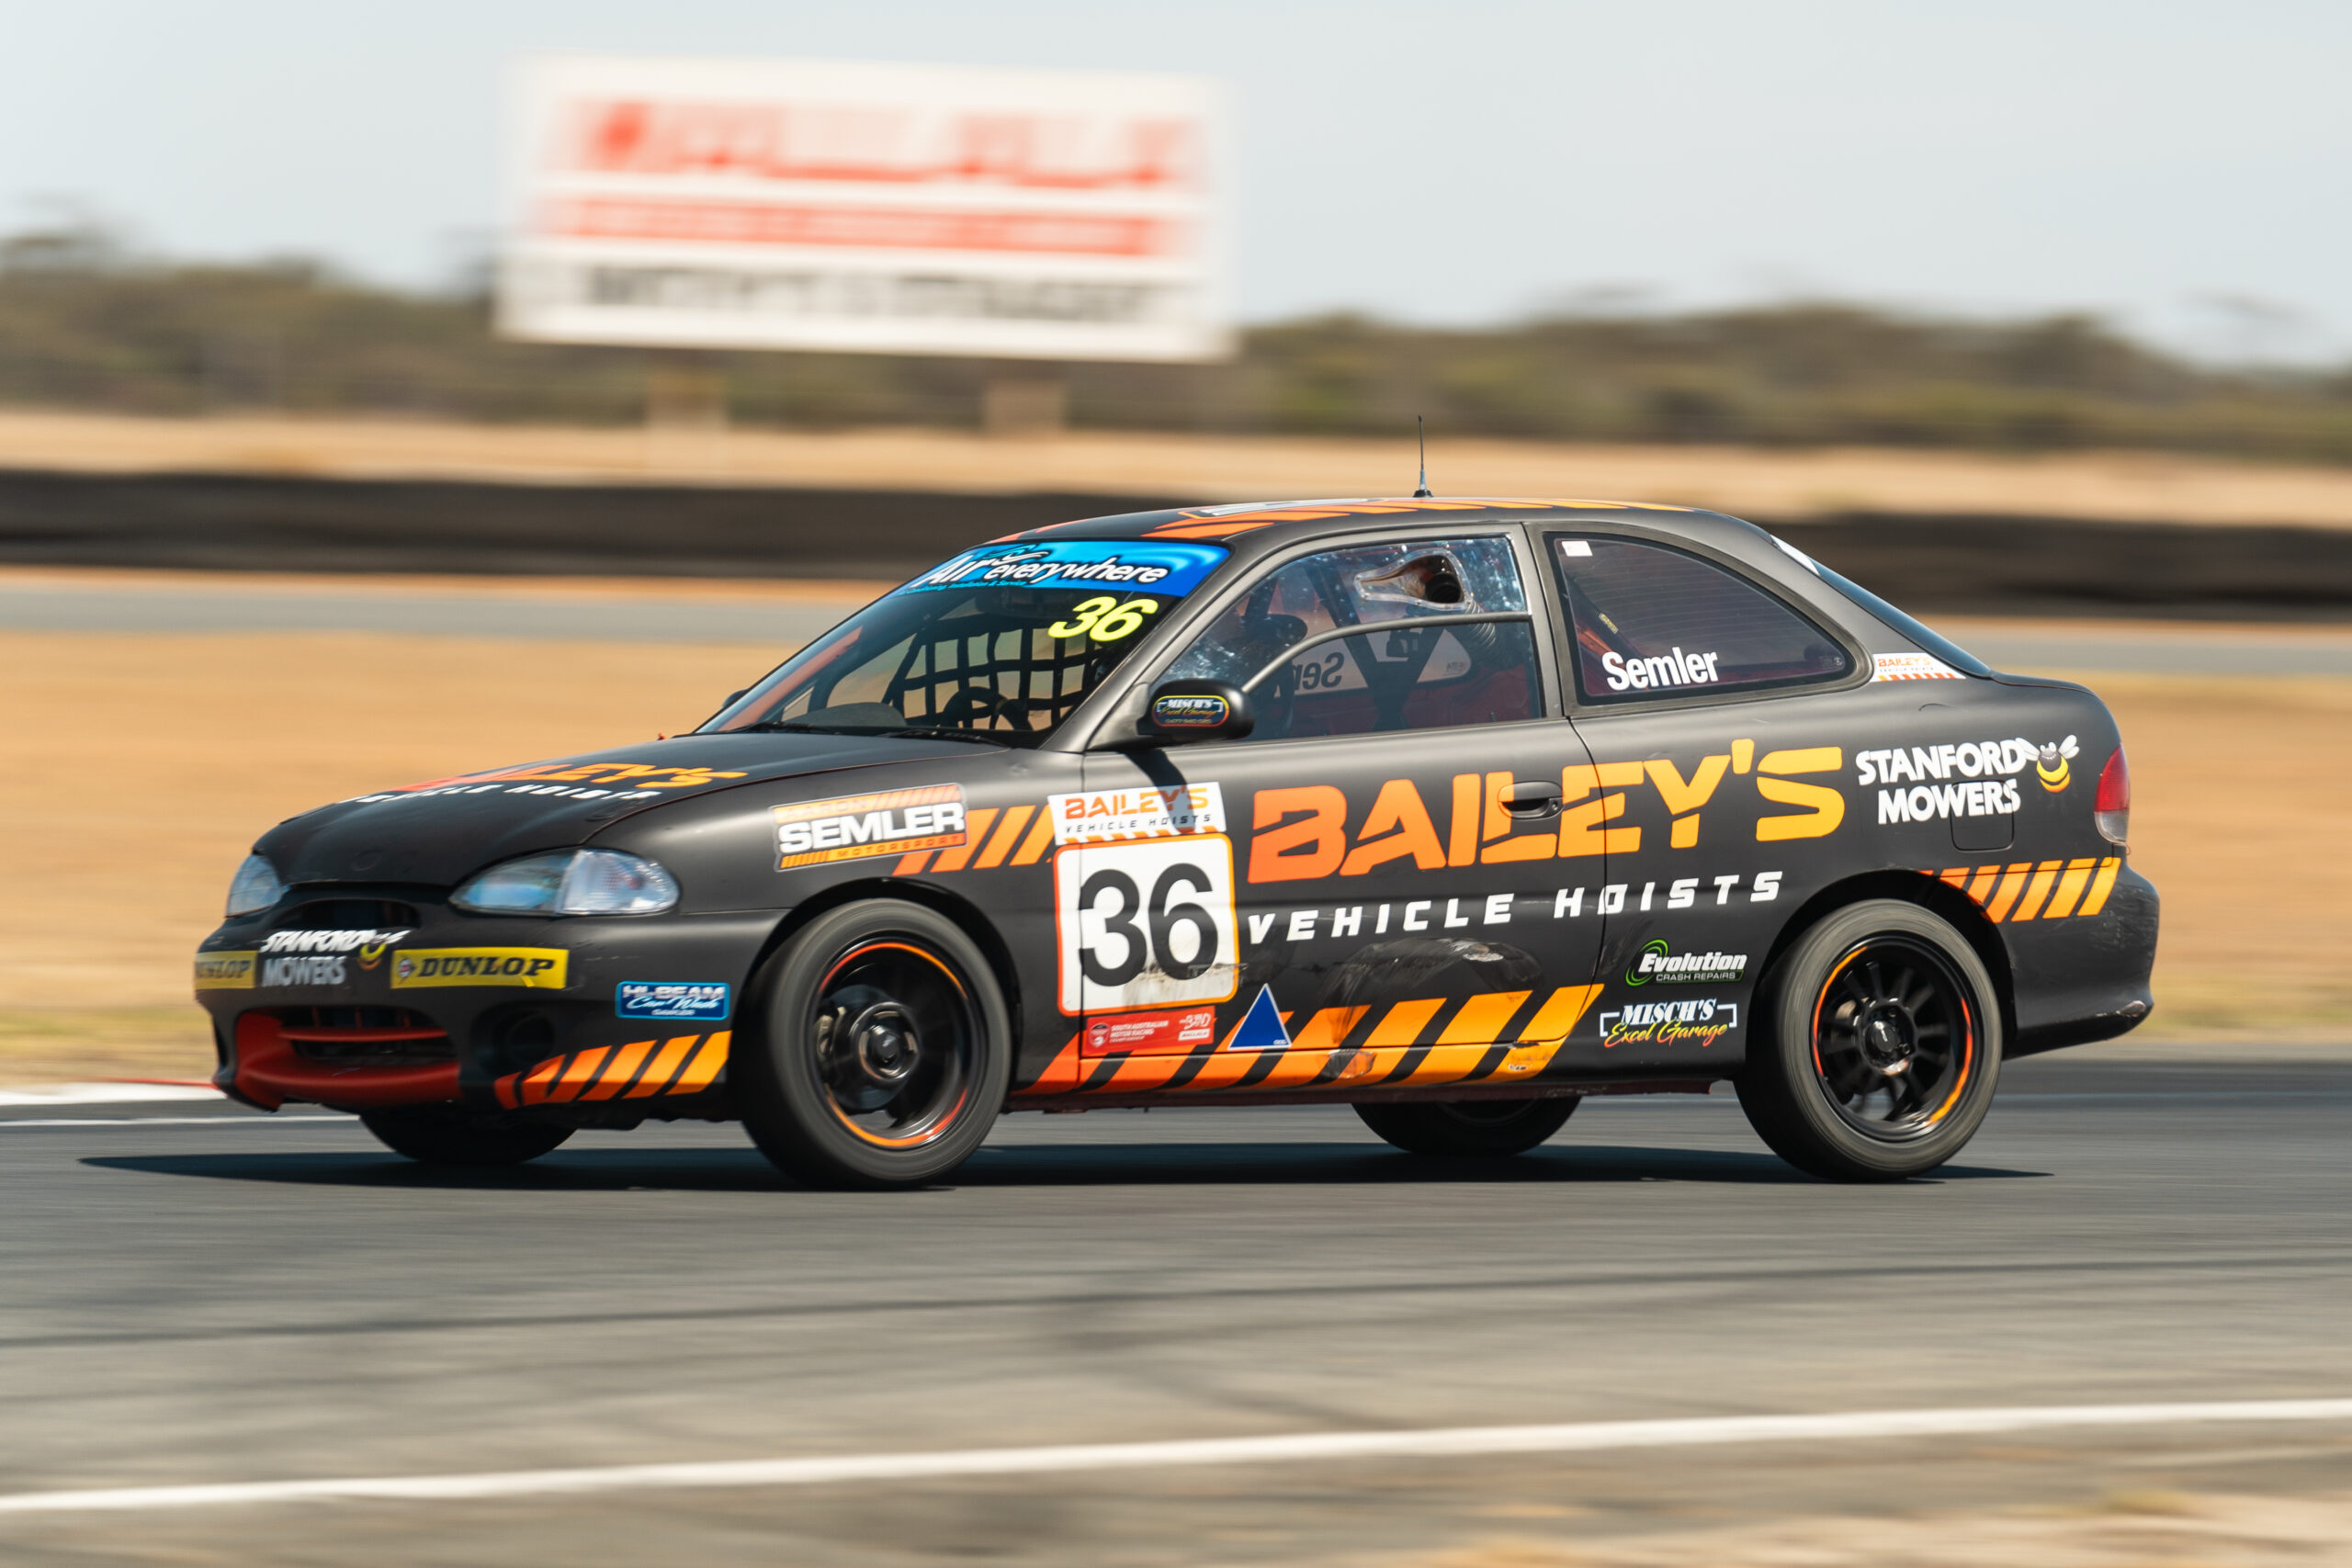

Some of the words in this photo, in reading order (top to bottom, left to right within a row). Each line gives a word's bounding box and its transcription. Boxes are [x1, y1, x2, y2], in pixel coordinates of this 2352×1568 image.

[911, 554, 992, 587] Air
[984, 557, 1168, 584] everywhere
[1047, 596, 1159, 642] 36
[1601, 647, 1718, 691] Semler
[1855, 739, 2027, 786] STANFORD
[1064, 784, 1209, 819] BAILEY'S
[1247, 738, 1845, 885] BAILEY'S
[1877, 779, 2020, 825] MOWERS
[778, 802, 966, 854] SEMLER
[1066, 819, 1137, 833] VEHICLE
[1148, 814, 1212, 826] HOISTS
[836, 835, 958, 858] MOTORSPORT
[1249, 893, 1515, 945] VEHICLE
[1553, 871, 1783, 919] HOISTS
[260, 930, 377, 953] STANFORD
[1079, 863, 1219, 987] 36
[262, 955, 348, 987] MOWERS
[417, 955, 555, 980] DUNLOP
[1638, 952, 1747, 973] Evolution
[1656, 973, 1691, 981] CRASH
[1693, 972, 1736, 980] REPAIRS
[1621, 998, 1717, 1026] MISCH'S
[1603, 1021, 1657, 1048] Excel
[1657, 1018, 1728, 1047] Garage
